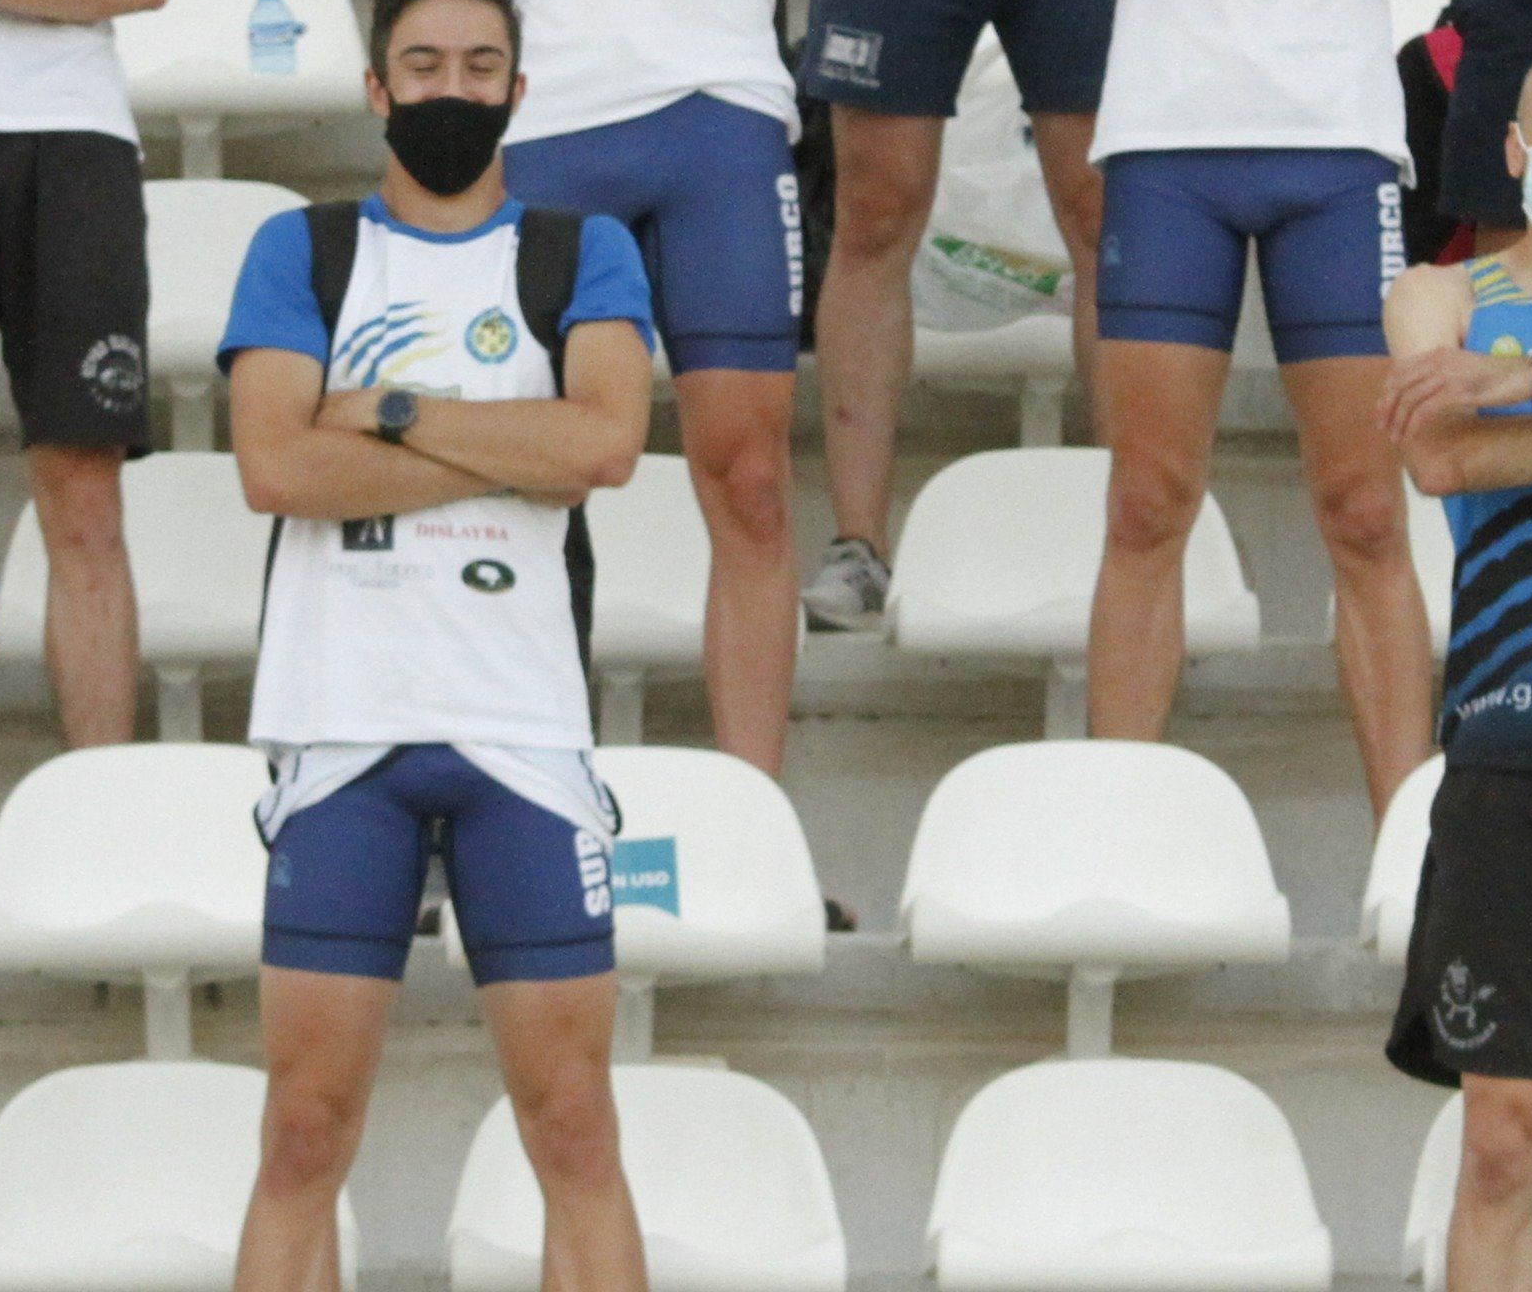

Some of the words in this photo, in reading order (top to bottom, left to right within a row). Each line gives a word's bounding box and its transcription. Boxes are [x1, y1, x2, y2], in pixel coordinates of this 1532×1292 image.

[1377, 183, 1406, 299] URCO
[611, 874, 626, 888] N
[630, 870, 669, 888] USO
